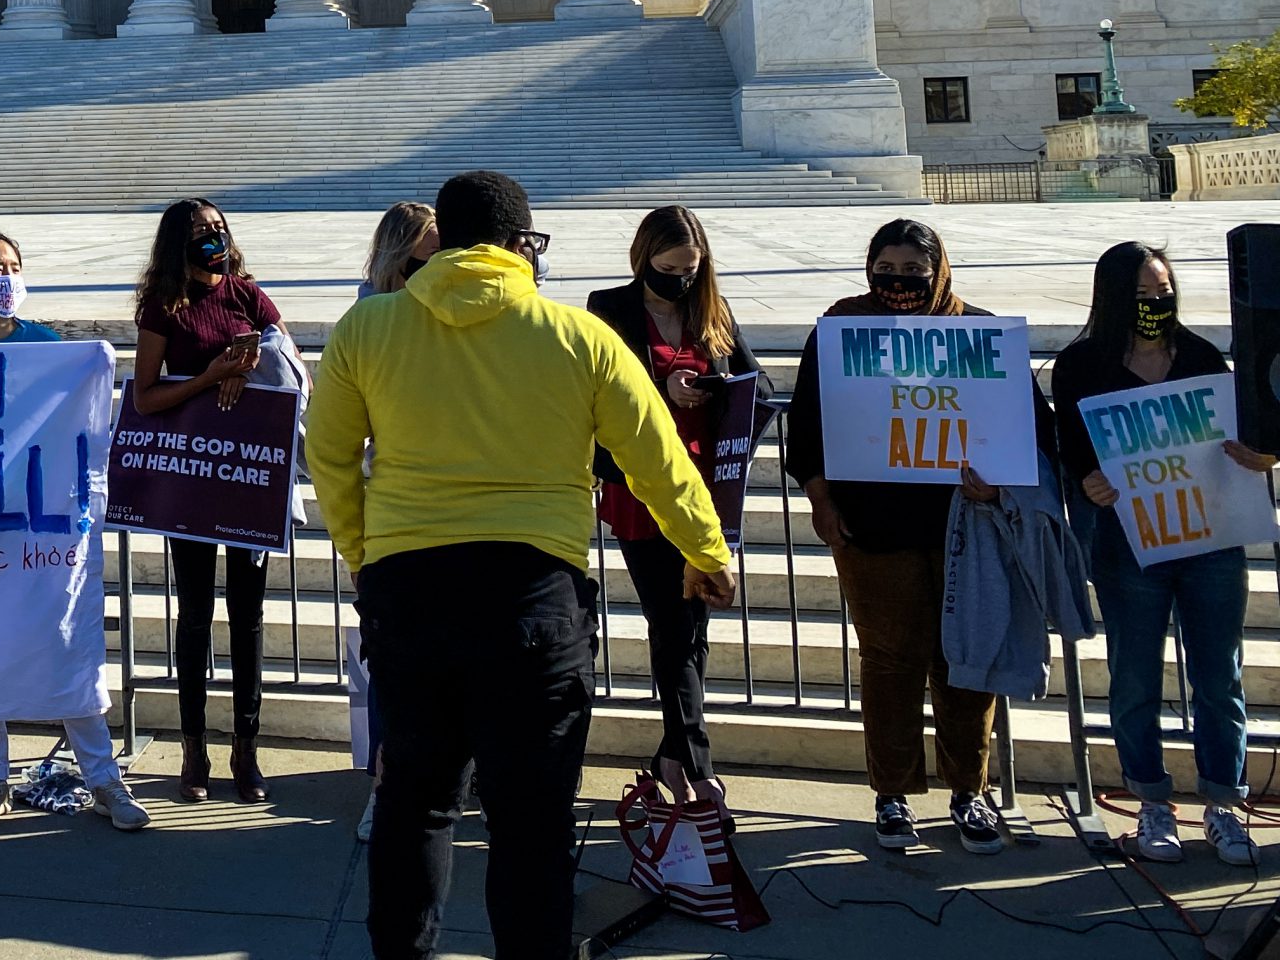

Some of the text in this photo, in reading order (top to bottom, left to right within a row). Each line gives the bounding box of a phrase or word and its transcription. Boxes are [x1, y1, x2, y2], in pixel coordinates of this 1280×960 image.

[841, 328, 1007, 380] MEDICINE
[891, 384, 963, 412] FOR
[1083, 387, 1226, 461] EDICINE
[116, 430, 287, 465] STOP THE GOP WAR
[731, 436, 749, 455] WAR
[888, 417, 970, 470] ALL!
[121, 452, 271, 487] ON HEALTH CARE
[722, 462, 741, 480] CARE
[1123, 453, 1193, 489] FOR
[123, 513, 145, 523] CARE
[215, 524, 279, 542] ProtectOurCare.org
[1131, 485, 1212, 550] ALL!
[944, 560, 957, 615] ACTION
